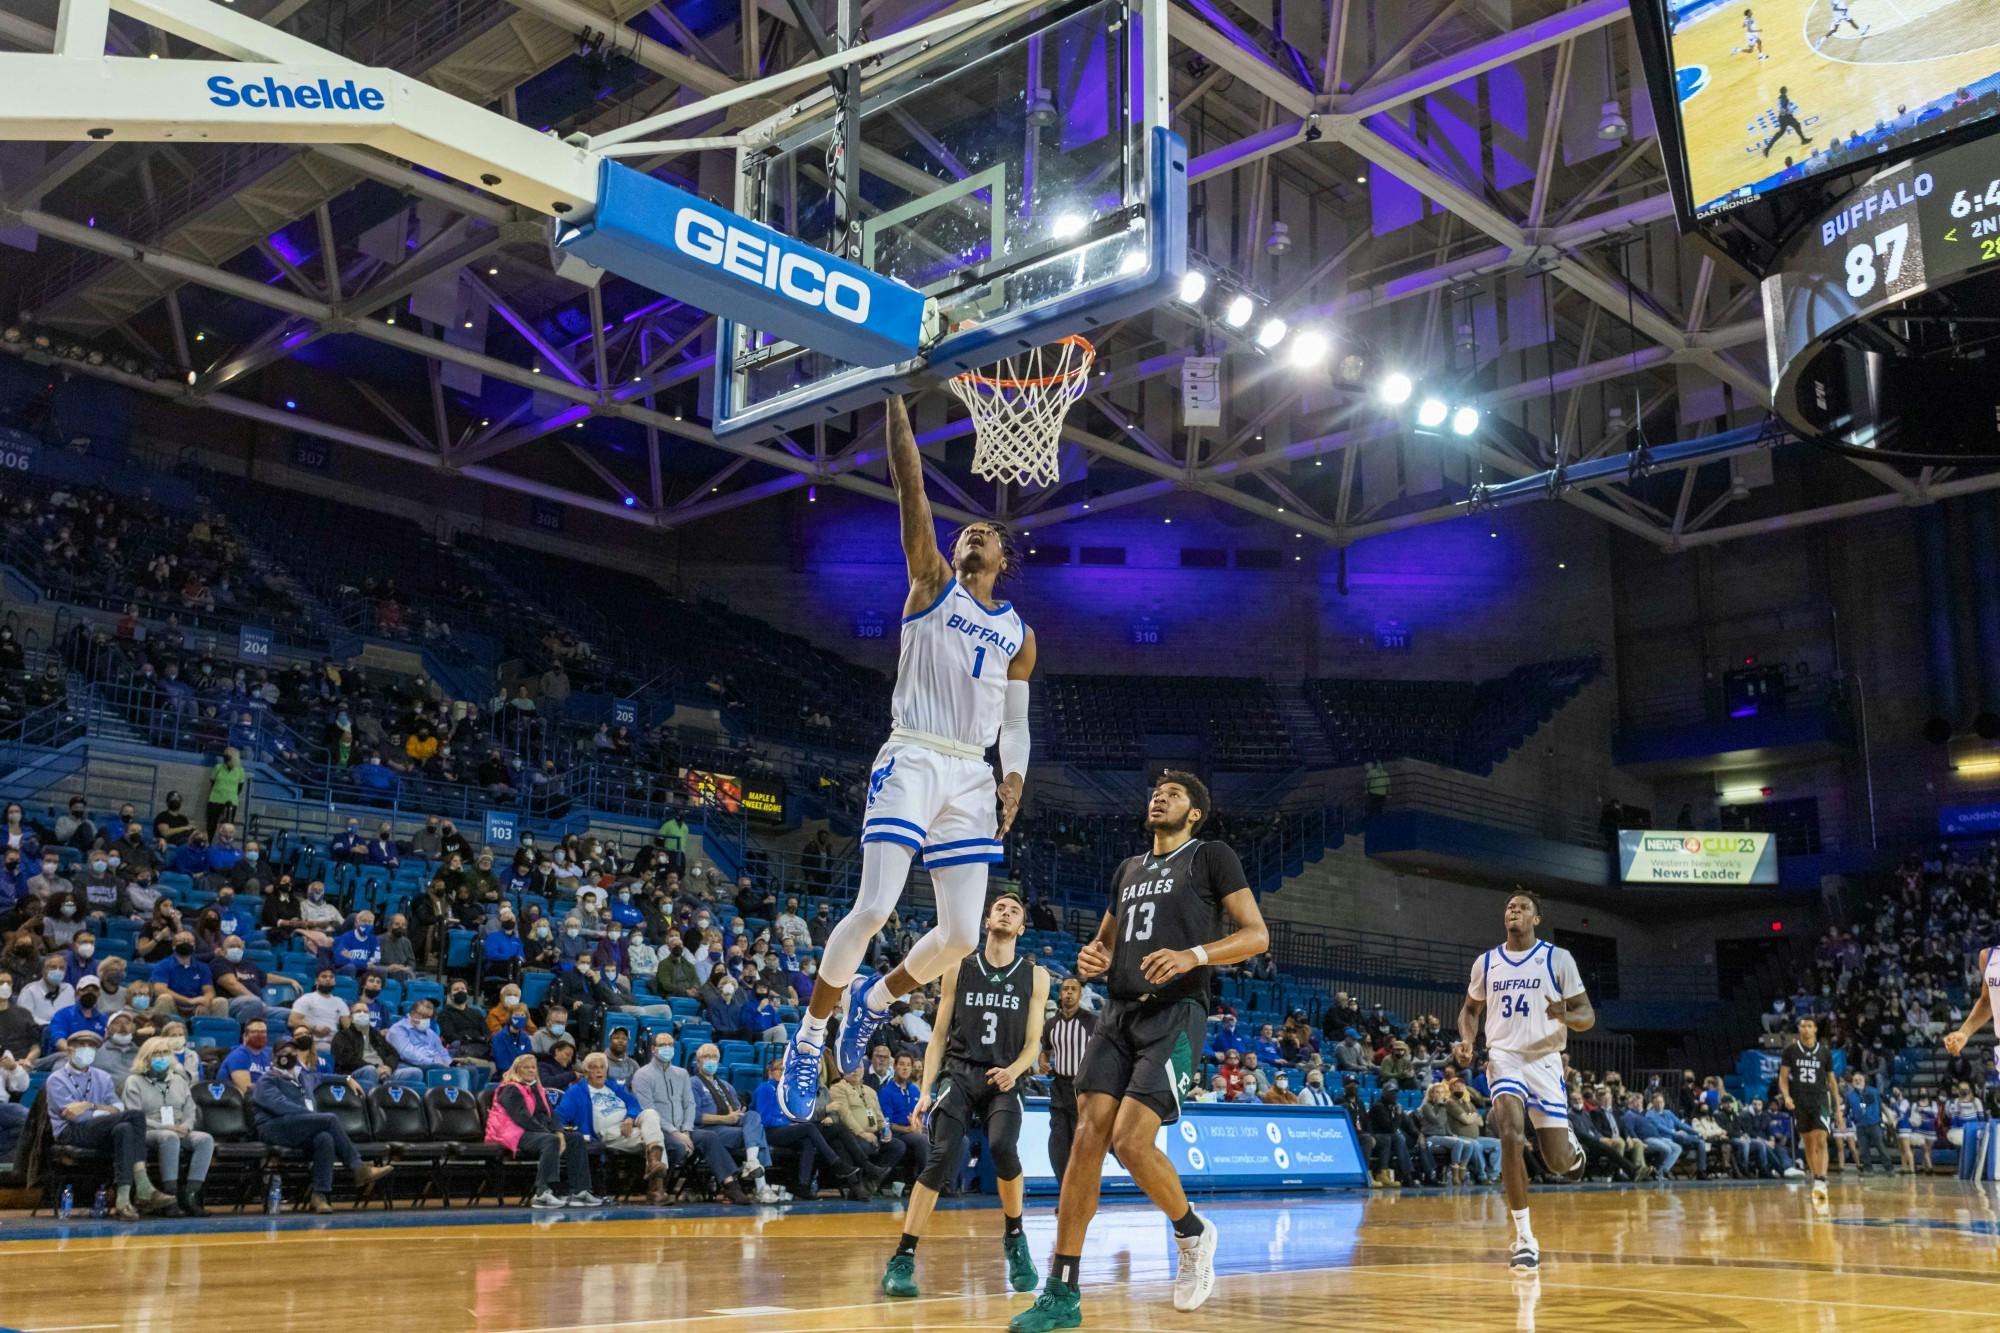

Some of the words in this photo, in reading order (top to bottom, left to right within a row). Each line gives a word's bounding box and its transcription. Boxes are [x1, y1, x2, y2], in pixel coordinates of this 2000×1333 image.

[206, 75, 385, 111] Schelde
[1696, 193, 1761, 219] DAKTRONICS
[1821, 172, 1934, 247] BUFFALO
[1970, 215, 2000, 238] 2N
[674, 206, 871, 324] GEICO
[1844, 222, 1909, 298] 87
[857, 625, 882, 638] 309
[946, 613, 1017, 657] BUFFALO
[1135, 632, 1158, 643] 310
[243, 640, 268, 656] 204
[1383, 636, 1405, 648] 311
[971, 645, 987, 680] 1
[616, 710, 634, 724] 205
[748, 791, 770, 802] MAPLE
[491, 827, 513, 841] 103
[1647, 838, 1682, 850] NEWS
[1652, 867, 1689, 879] News
[1693, 868, 1741, 880] Leader
[1121, 879, 1174, 903] EAGLES
[1124, 902, 1155, 942] 13
[1492, 978, 1541, 992] BUFFALO
[965, 992, 1020, 1010] EAGLES
[1501, 994, 1530, 1018] 34
[980, 1011, 998, 1045] 3
[1799, 1067, 1817, 1084] 25
